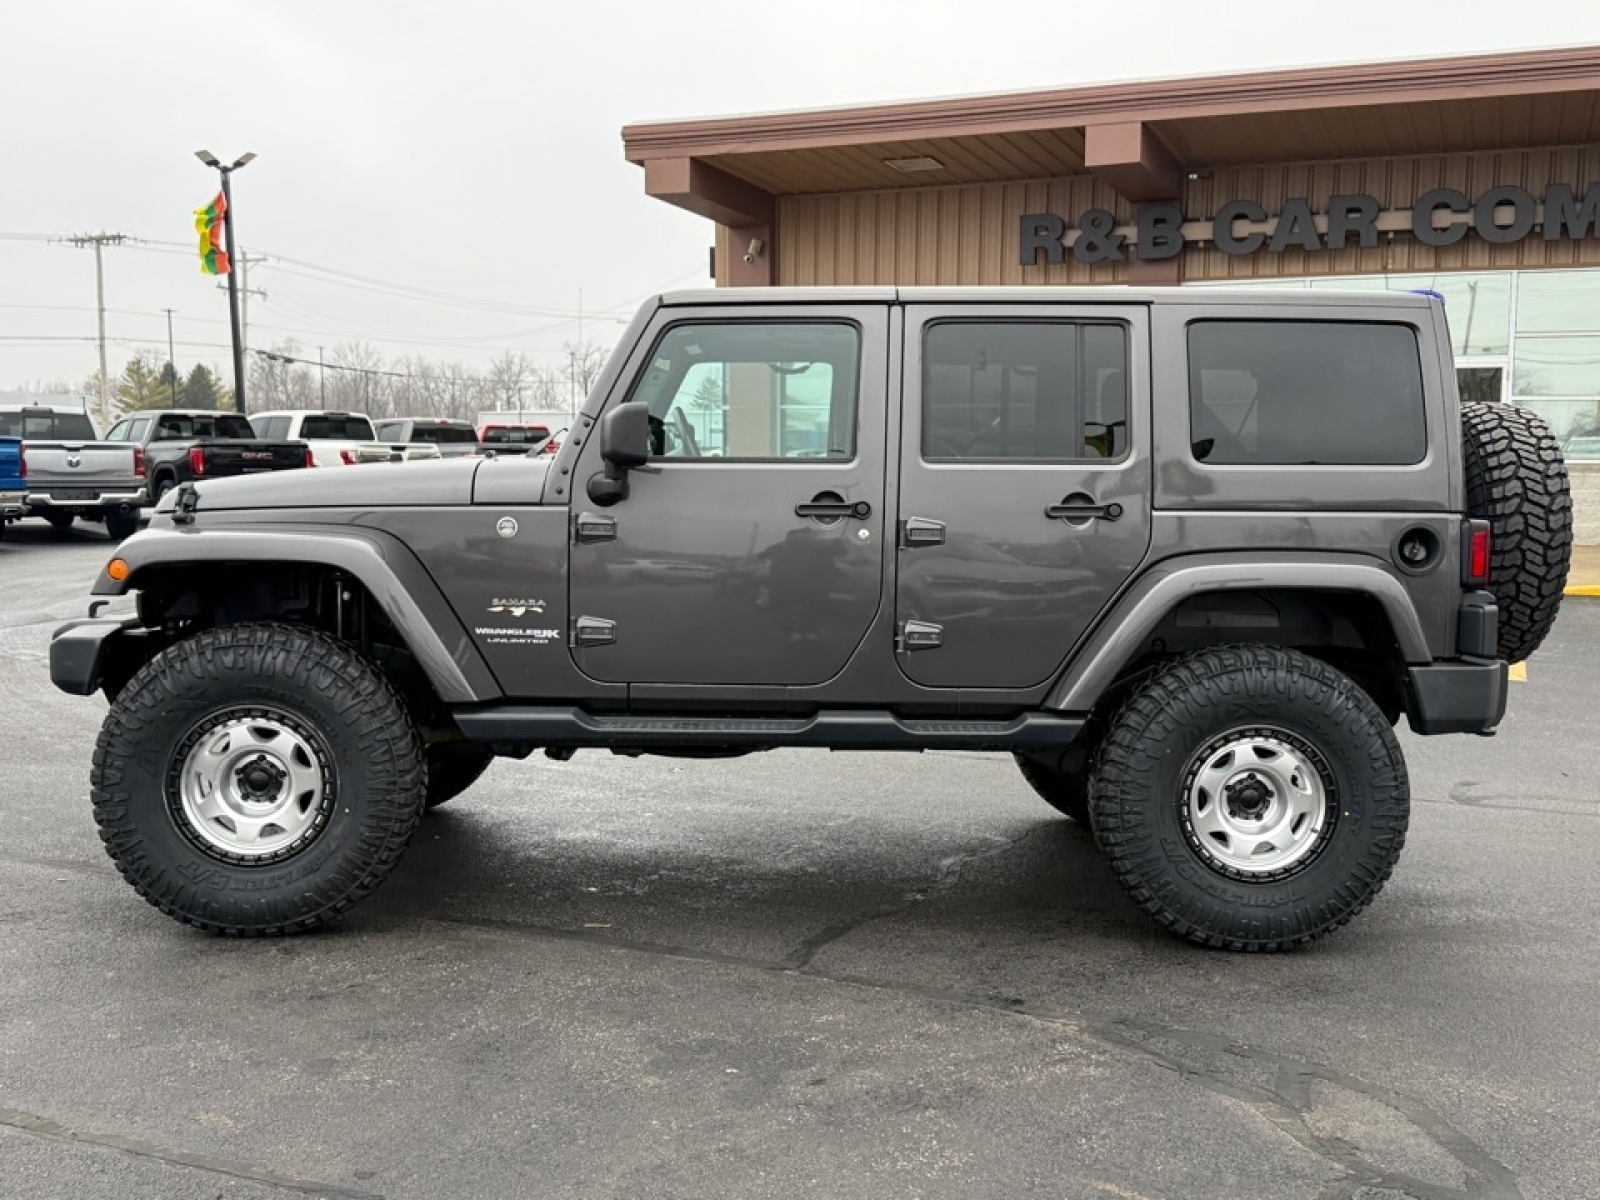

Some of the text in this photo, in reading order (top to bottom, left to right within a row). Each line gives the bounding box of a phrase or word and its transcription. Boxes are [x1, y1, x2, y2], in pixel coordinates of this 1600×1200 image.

[1020, 183, 1600, 265] R&B CAR COM
